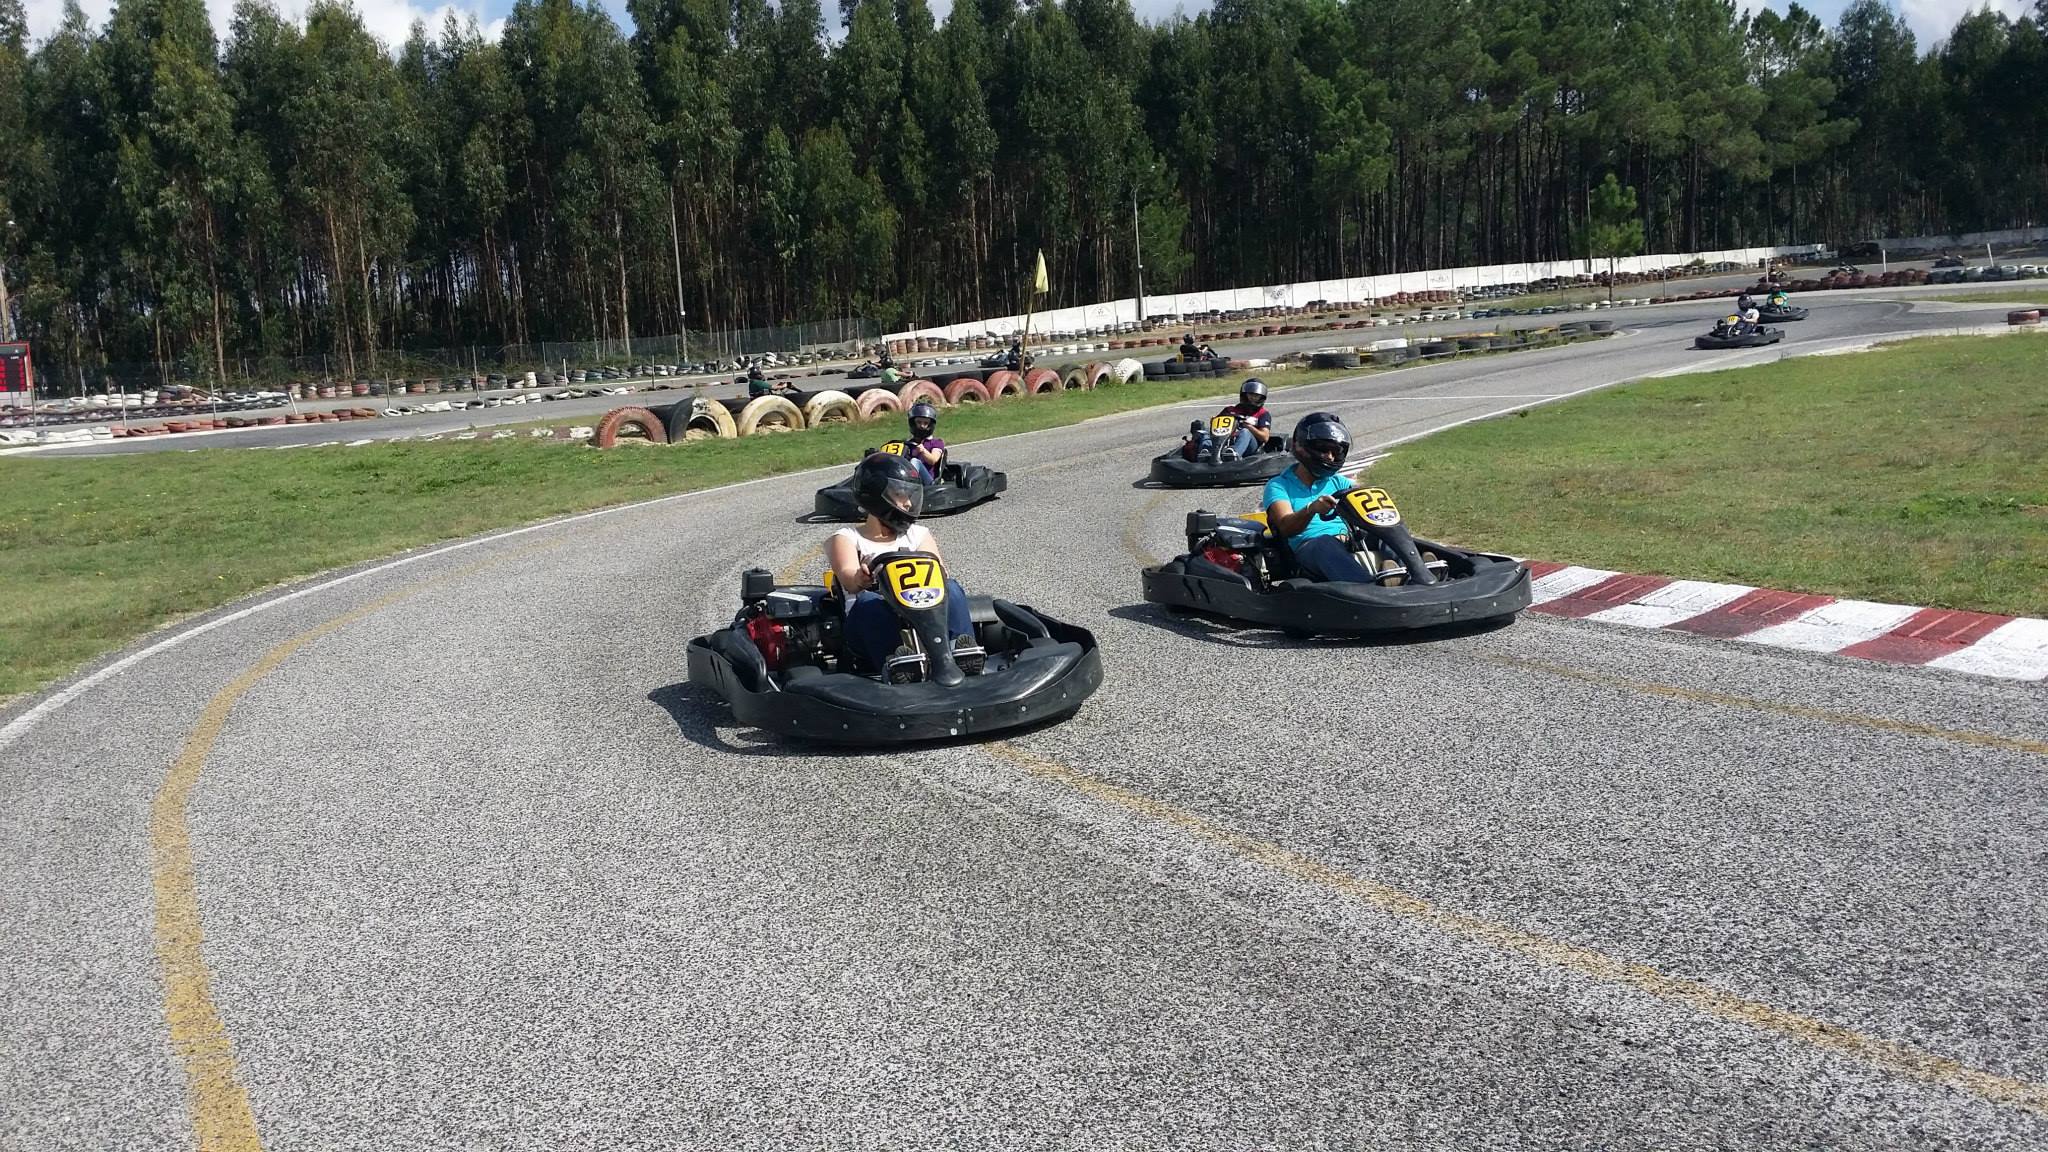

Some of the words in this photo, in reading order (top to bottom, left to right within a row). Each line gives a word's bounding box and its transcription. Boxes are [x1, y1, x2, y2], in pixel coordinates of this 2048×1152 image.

[1216, 417, 1232, 429] 19
[1353, 490, 1395, 513] 22
[896, 560, 935, 591] 27
